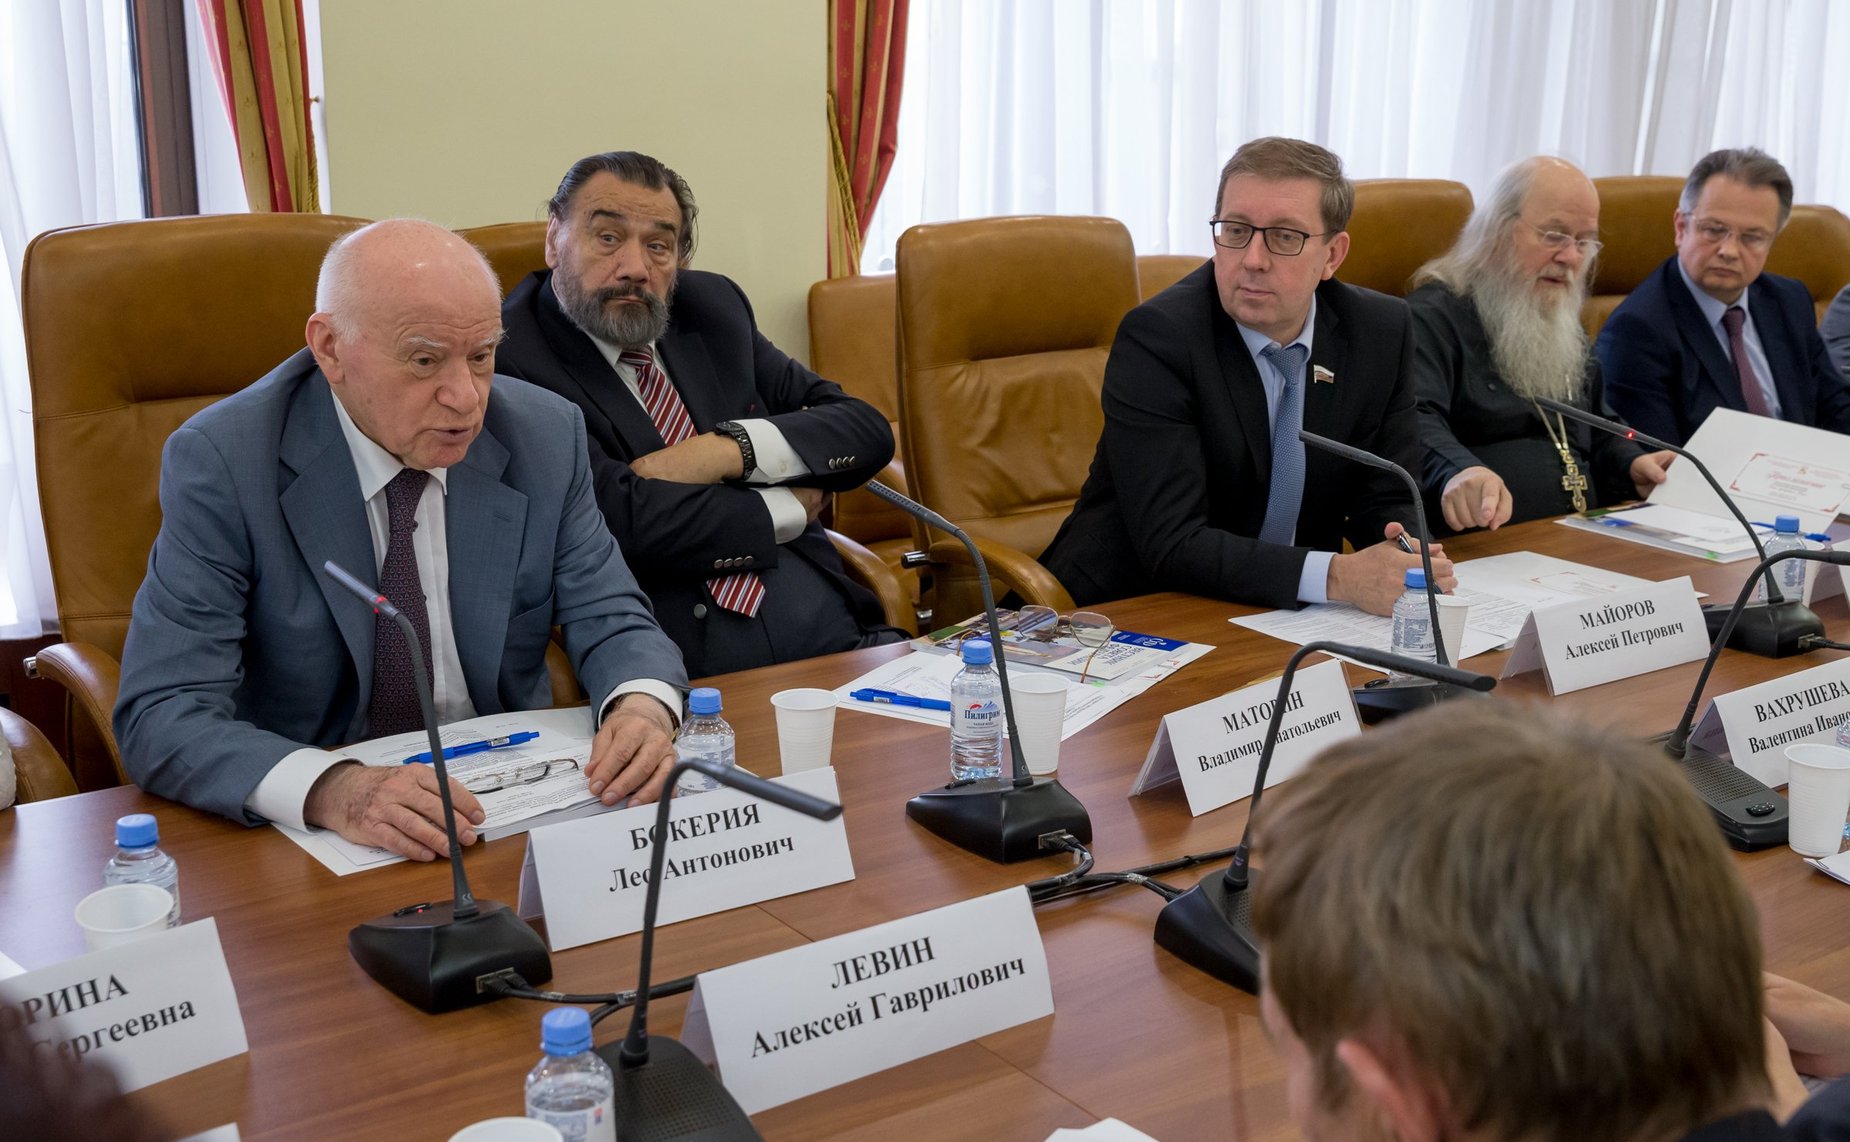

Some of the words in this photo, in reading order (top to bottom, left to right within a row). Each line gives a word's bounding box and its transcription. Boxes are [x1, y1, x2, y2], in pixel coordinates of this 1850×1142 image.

[1579, 599, 1656, 630] МАЙОРОВ
[1565, 633, 1620, 660] Алексей
[1620, 622, 1685, 646] Петрович
[1753, 679, 1850, 723] ВАХРУШЕВА
[1197, 739, 1264, 772] Владимир
[1275, 710, 1342, 744] натольевич
[1748, 723, 1815, 754] Валентина
[663, 837, 795, 880] Антонович
[831, 936, 937, 989] ЛЕВИН
[4, 973, 129, 1029] РИНА
[751, 1002, 864, 1058] Алексей
[869, 958, 1026, 1020] Гаврилович
